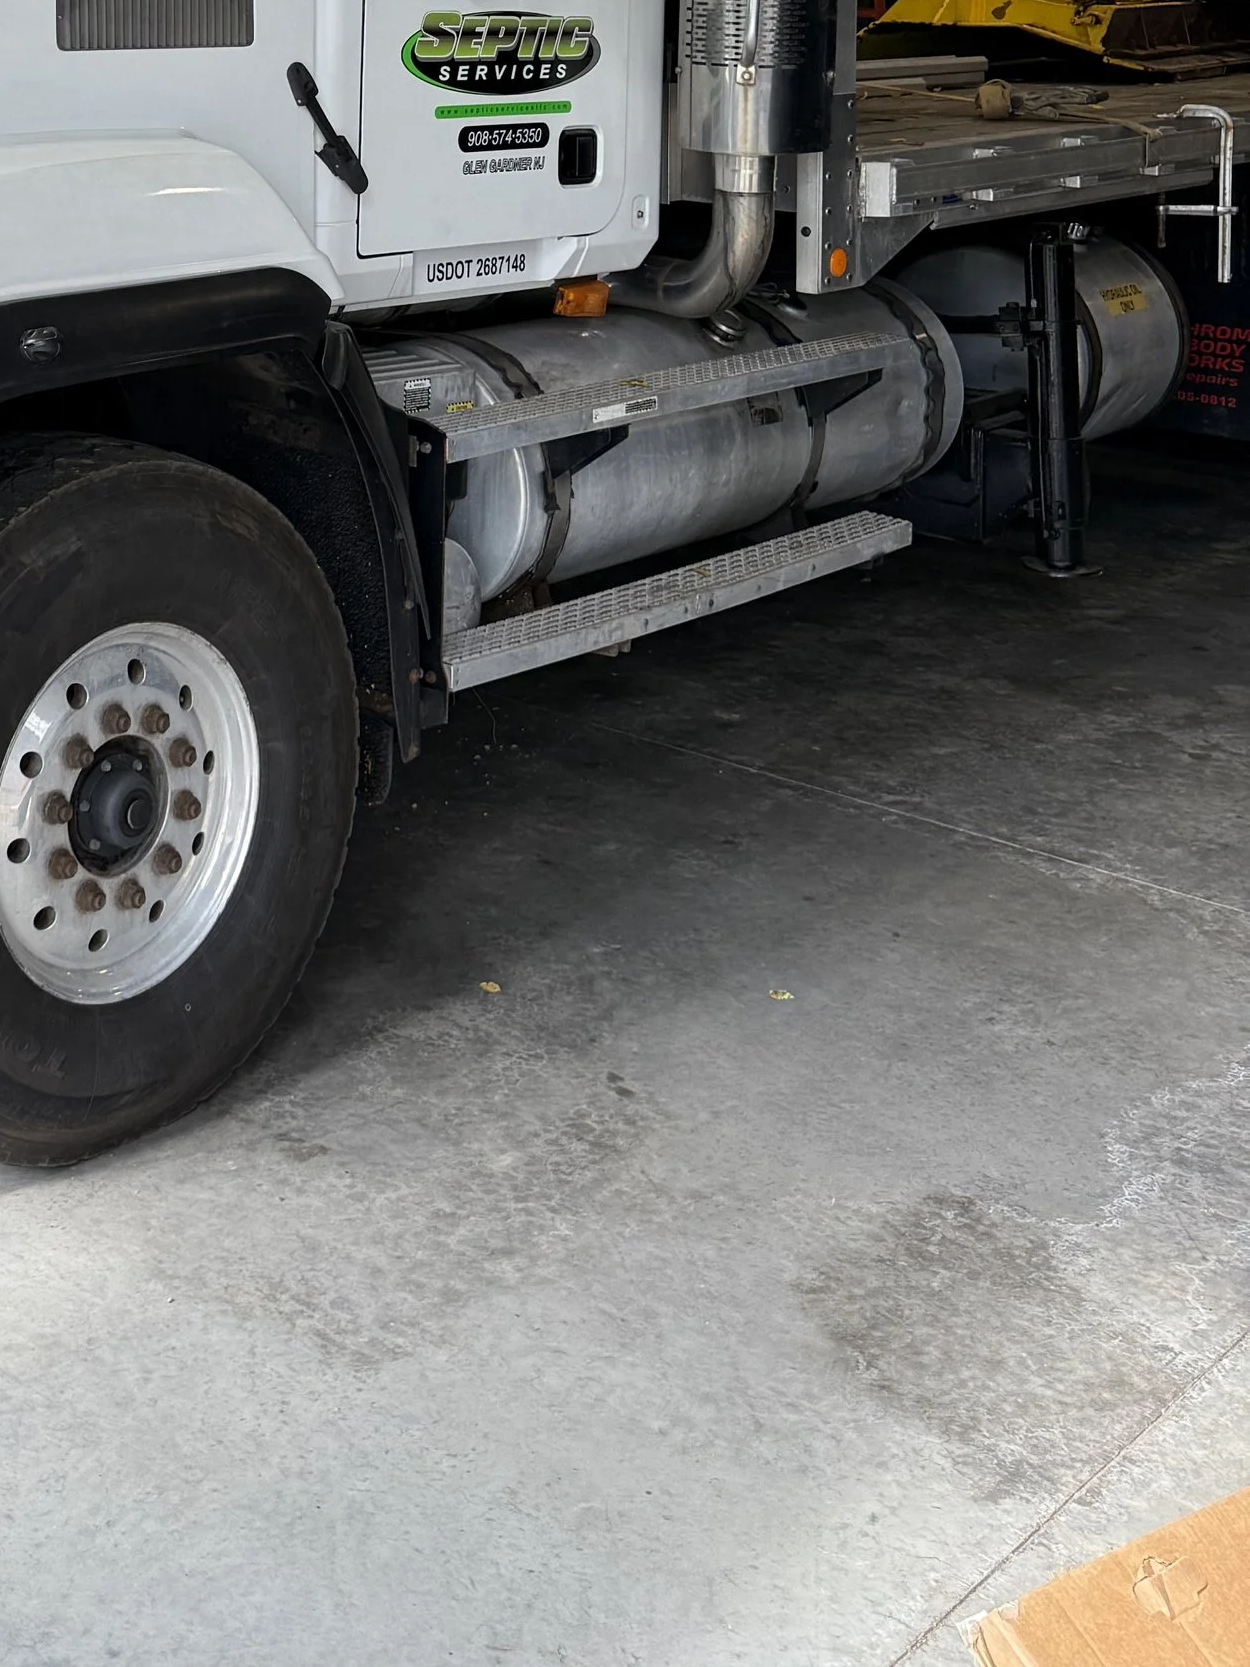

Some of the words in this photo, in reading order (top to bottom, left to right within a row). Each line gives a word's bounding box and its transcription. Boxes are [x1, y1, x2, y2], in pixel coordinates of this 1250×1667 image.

[414, 11, 595, 62] SEPTIC
[438, 63, 568, 81] SERVICES
[462, 159, 488, 176] GLEN
[489, 156, 532, 174] GARDNER
[533, 155, 546, 171] NJ
[426, 259, 473, 283] USDOT
[476, 253, 526, 276] 2687148
